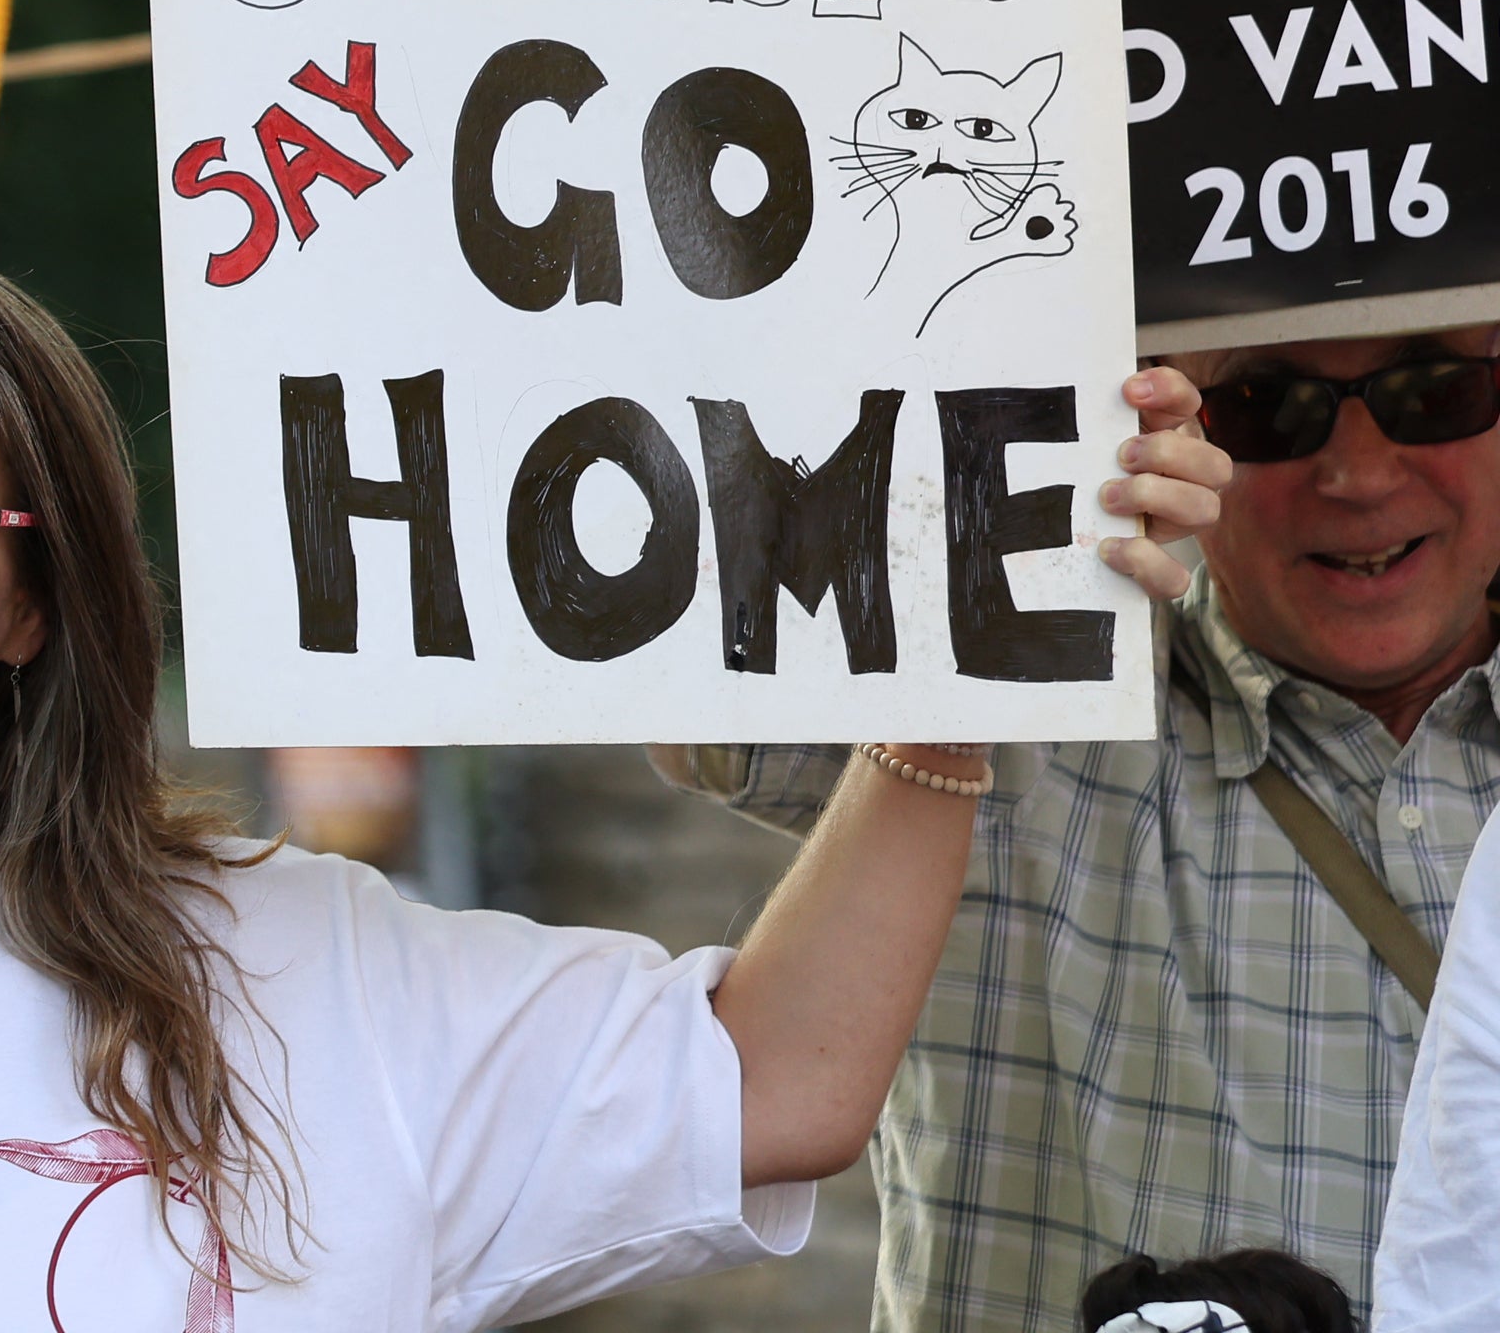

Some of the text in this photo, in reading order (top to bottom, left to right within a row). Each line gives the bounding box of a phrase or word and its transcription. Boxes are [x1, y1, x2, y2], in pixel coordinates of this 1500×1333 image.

[171, 37, 816, 313] SAY GO
[1183, 142, 1450, 267] 2016
[279, 366, 1118, 682] HOME
